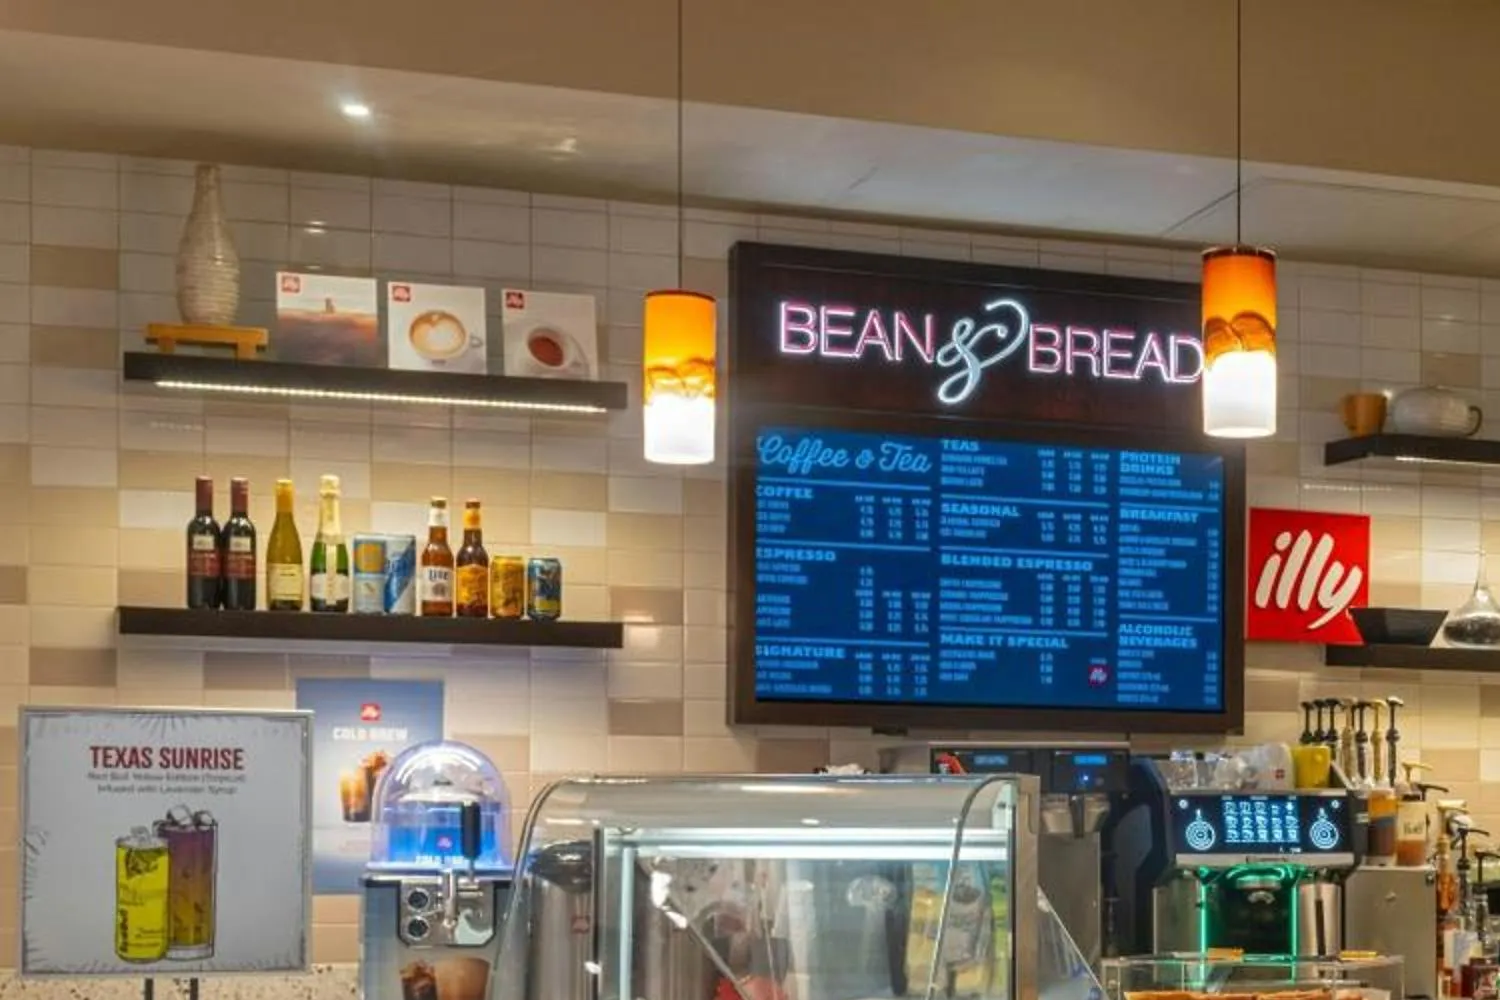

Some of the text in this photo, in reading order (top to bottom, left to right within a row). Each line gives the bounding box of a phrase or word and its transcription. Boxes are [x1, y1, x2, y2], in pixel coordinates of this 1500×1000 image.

[779, 298, 1204, 403] BEAN & BREAD
[941, 438, 980, 453] TEAS
[756, 434, 849, 475] Coffee
[879, 441, 932, 474] Tea
[756, 484, 814, 499] COFFEE
[940, 502, 1021, 518] SEASONAL
[756, 547, 837, 562] ESPRESSO
[941, 553, 1093, 571] BLENDED ESPRESSO
[1255, 529, 1363, 630] illy
[940, 634, 1070, 650] MAKE IT SPECIAL
[756, 644, 846, 659] SIGNATURE
[332, 726, 409, 742] COLD BREW
[89, 745, 245, 771] TEXAS SUNRISE
